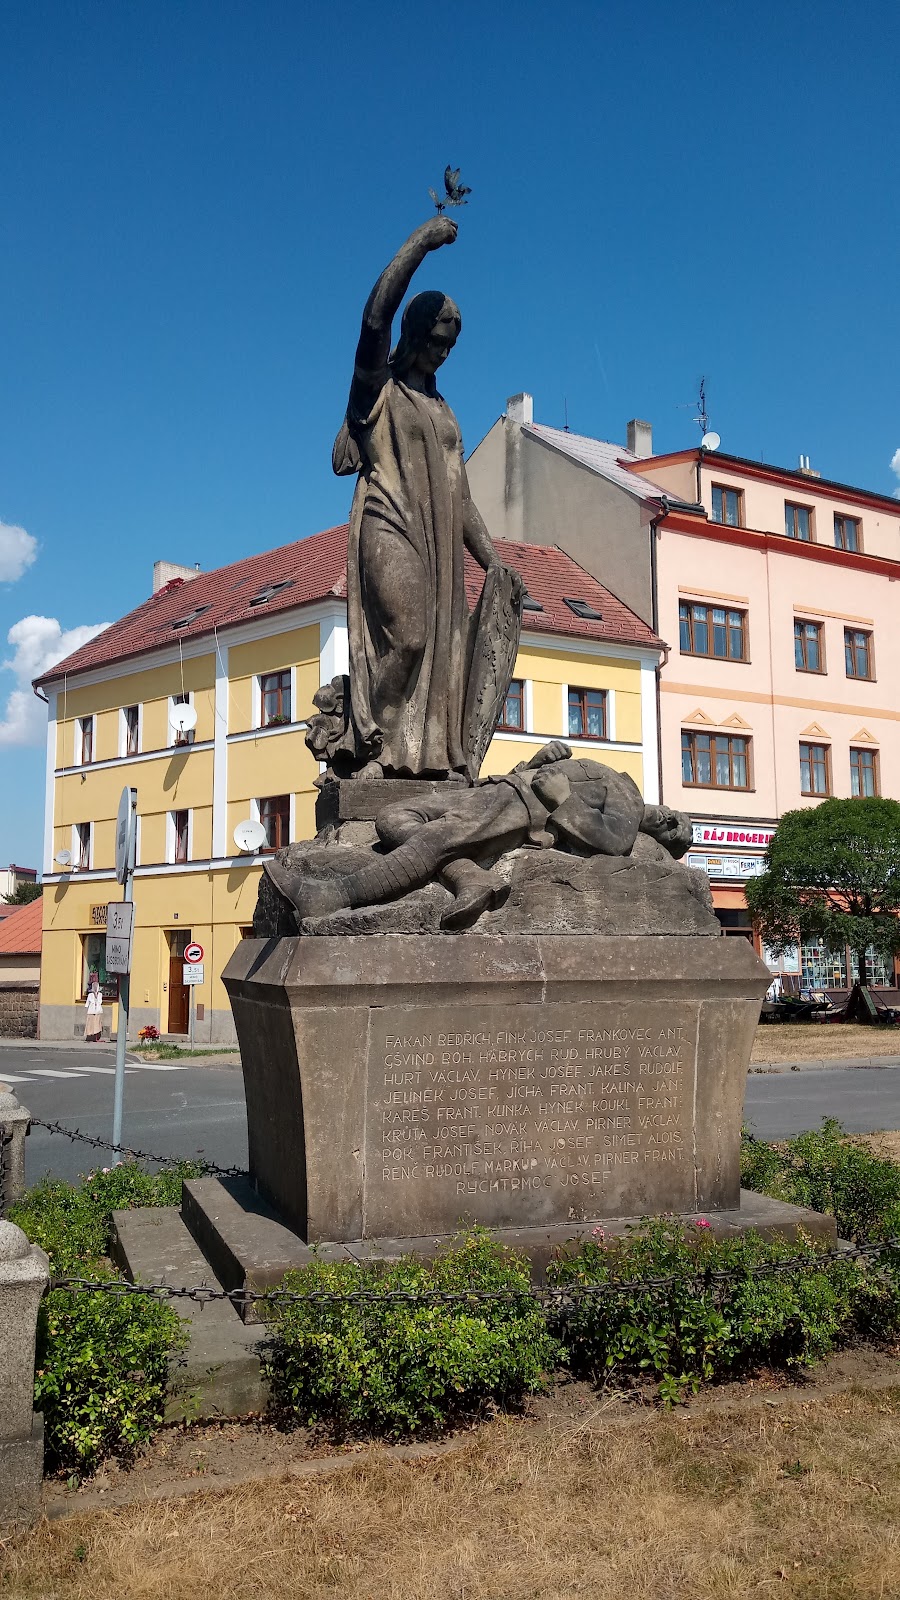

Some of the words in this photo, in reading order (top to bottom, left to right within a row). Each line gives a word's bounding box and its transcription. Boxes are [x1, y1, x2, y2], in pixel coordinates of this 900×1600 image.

[703, 828, 725, 841] RÁJ
[385, 1033, 432, 1048] FAKAN
[496, 1031, 526, 1044] FINK
[578, 1028, 652, 1042] FRANKOVEC
[384, 1070, 422, 1086] HURT
[488, 1066, 535, 1081] HYNEK
[588, 1061, 631, 1077] JAKEŠ
[601, 1081, 645, 1095] KALINA
[382, 1105, 430, 1124] KAREŠ
[592, 1098, 631, 1112] KOUKL
[586, 1115, 631, 1131] PIRNER
[382, 1147, 414, 1163] POK
[484, 1157, 538, 1174] MARKUP
[594, 1151, 639, 1166] PIRNER
[560, 1170, 612, 1186] JOSEF
